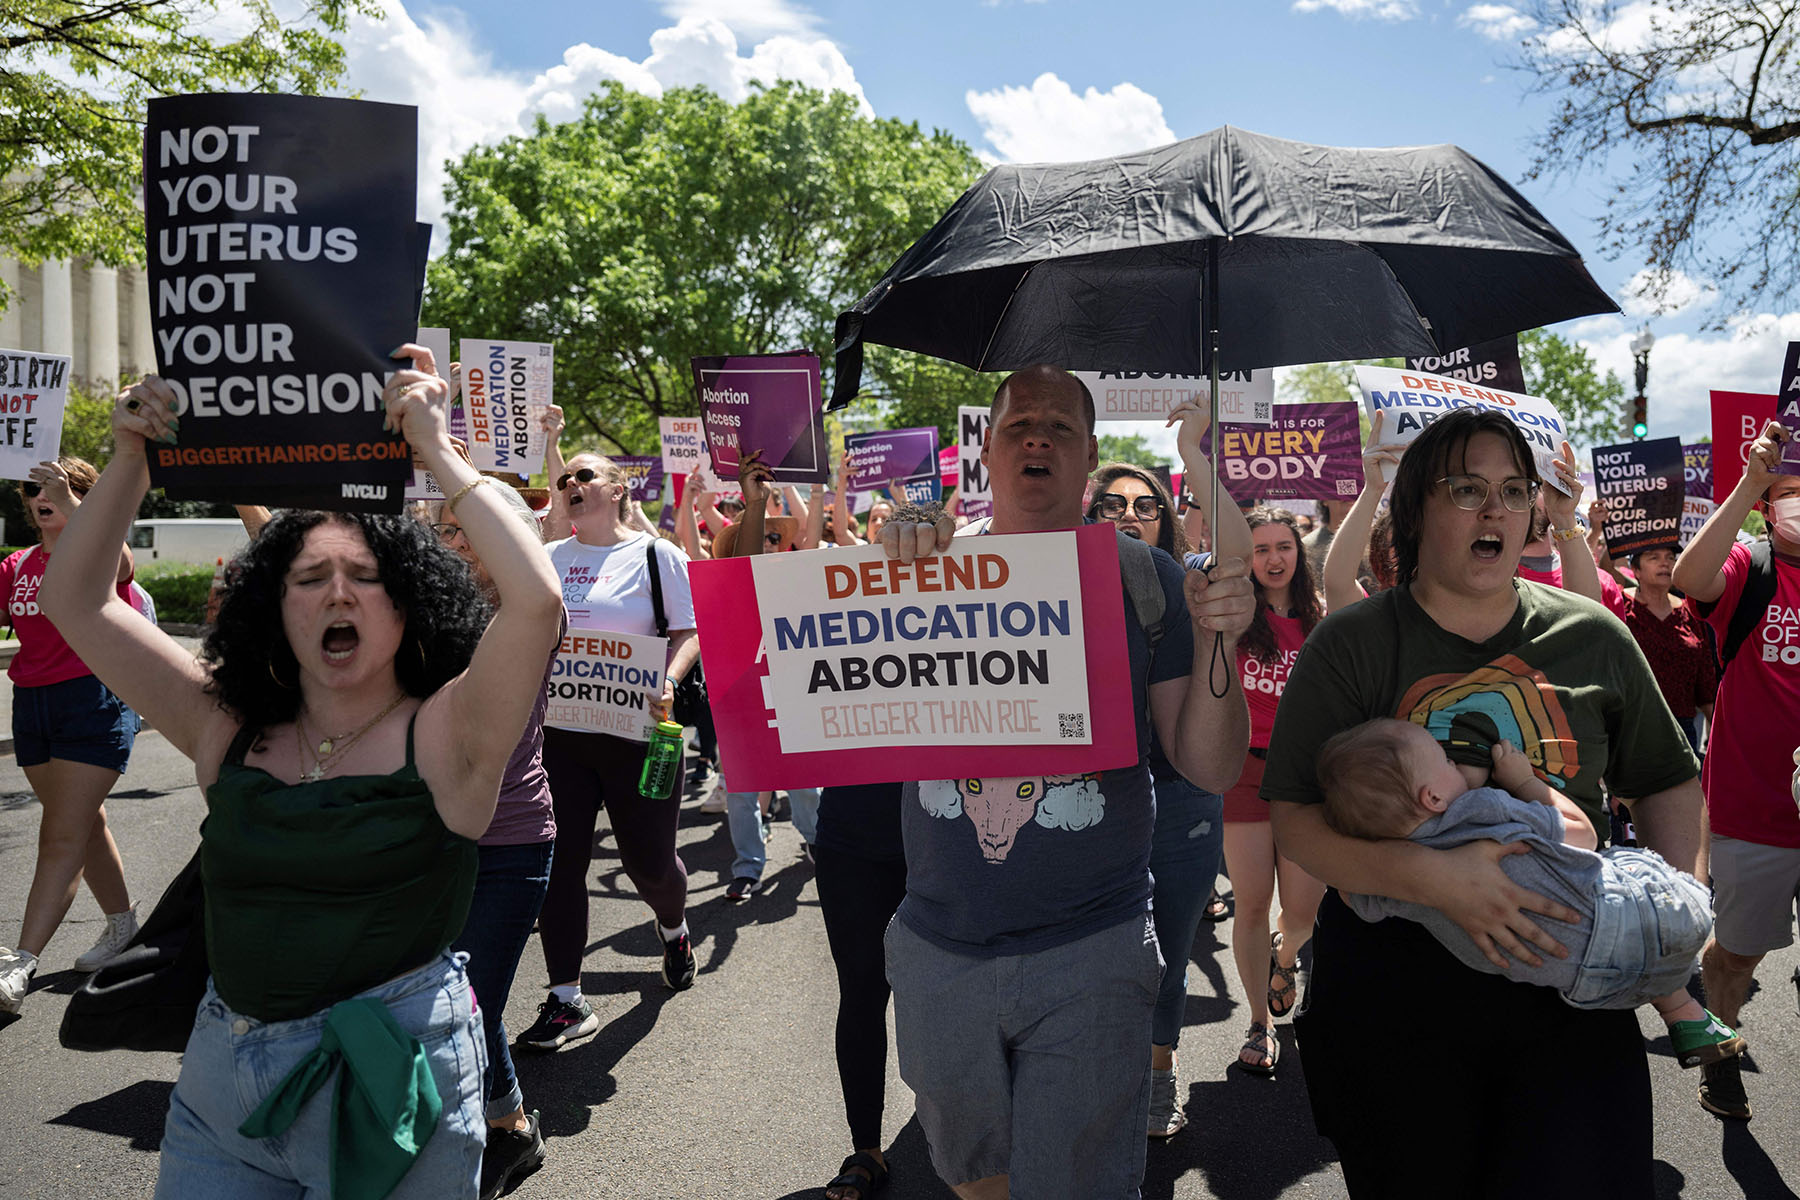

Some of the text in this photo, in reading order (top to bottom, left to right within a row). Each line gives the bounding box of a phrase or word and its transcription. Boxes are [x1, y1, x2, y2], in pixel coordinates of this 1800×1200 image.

[160, 125, 260, 168] NOT
[158, 174, 298, 216] YOUR
[159, 223, 358, 266] UTERUS
[158, 272, 256, 318] NOT
[158, 322, 295, 366] YOUR
[1410, 347, 1471, 372] YOUR
[0, 354, 66, 389] BIRTH
[702, 388, 750, 405] Abortion
[1105, 389, 1174, 413] BIGGER
[1219, 390, 1245, 414] ROE
[1401, 375, 1517, 407] DEFEND
[0, 393, 39, 414] NOT
[468, 368, 490, 443] DEFEND
[489, 346, 509, 467] MEDICATION
[511, 357, 528, 459] ABORTION
[706, 410, 741, 427] Access
[1284, 419, 1295, 429] IS
[1300, 418, 1326, 428] FOR
[663, 434, 697, 446] MEDIC
[710, 431, 725, 446] For
[1223, 430, 1326, 457] EVERY
[158, 442, 407, 467] BIGGERTHANROE.COM
[669, 448, 699, 458] ABOR
[849, 443, 893, 457] Abortion
[1596, 452, 1632, 466] NOT
[850, 455, 886, 467] Access
[868, 466, 882, 476] All
[1224, 454, 1328, 480] BODY
[1598, 464, 1647, 479] YOUR
[1684, 467, 1710, 483] DY
[342, 484, 387, 500] NYCLU
[904, 487, 933, 501] GHT!
[1600, 477, 1668, 495] UTERUS
[1602, 495, 1636, 509] NOT
[1682, 501, 1709, 515] END
[1605, 517, 1677, 540] DECISION
[568, 566, 591, 575] WE
[824, 553, 1010, 600] DEFEND
[562, 593, 593, 603] ACK.
[774, 599, 1071, 651] MEDICATION
[1766, 605, 1800, 625] BA
[1762, 624, 1799, 645] OF
[558, 636, 633, 660] EFEND
[1762, 644, 1800, 665] BO
[807, 649, 1050, 694] ABORTION
[548, 682, 645, 710] BORTION
[820, 701, 921, 739] BIGGER
[922, 699, 993, 735] THAN
[1000, 698, 1042, 734] ROE
